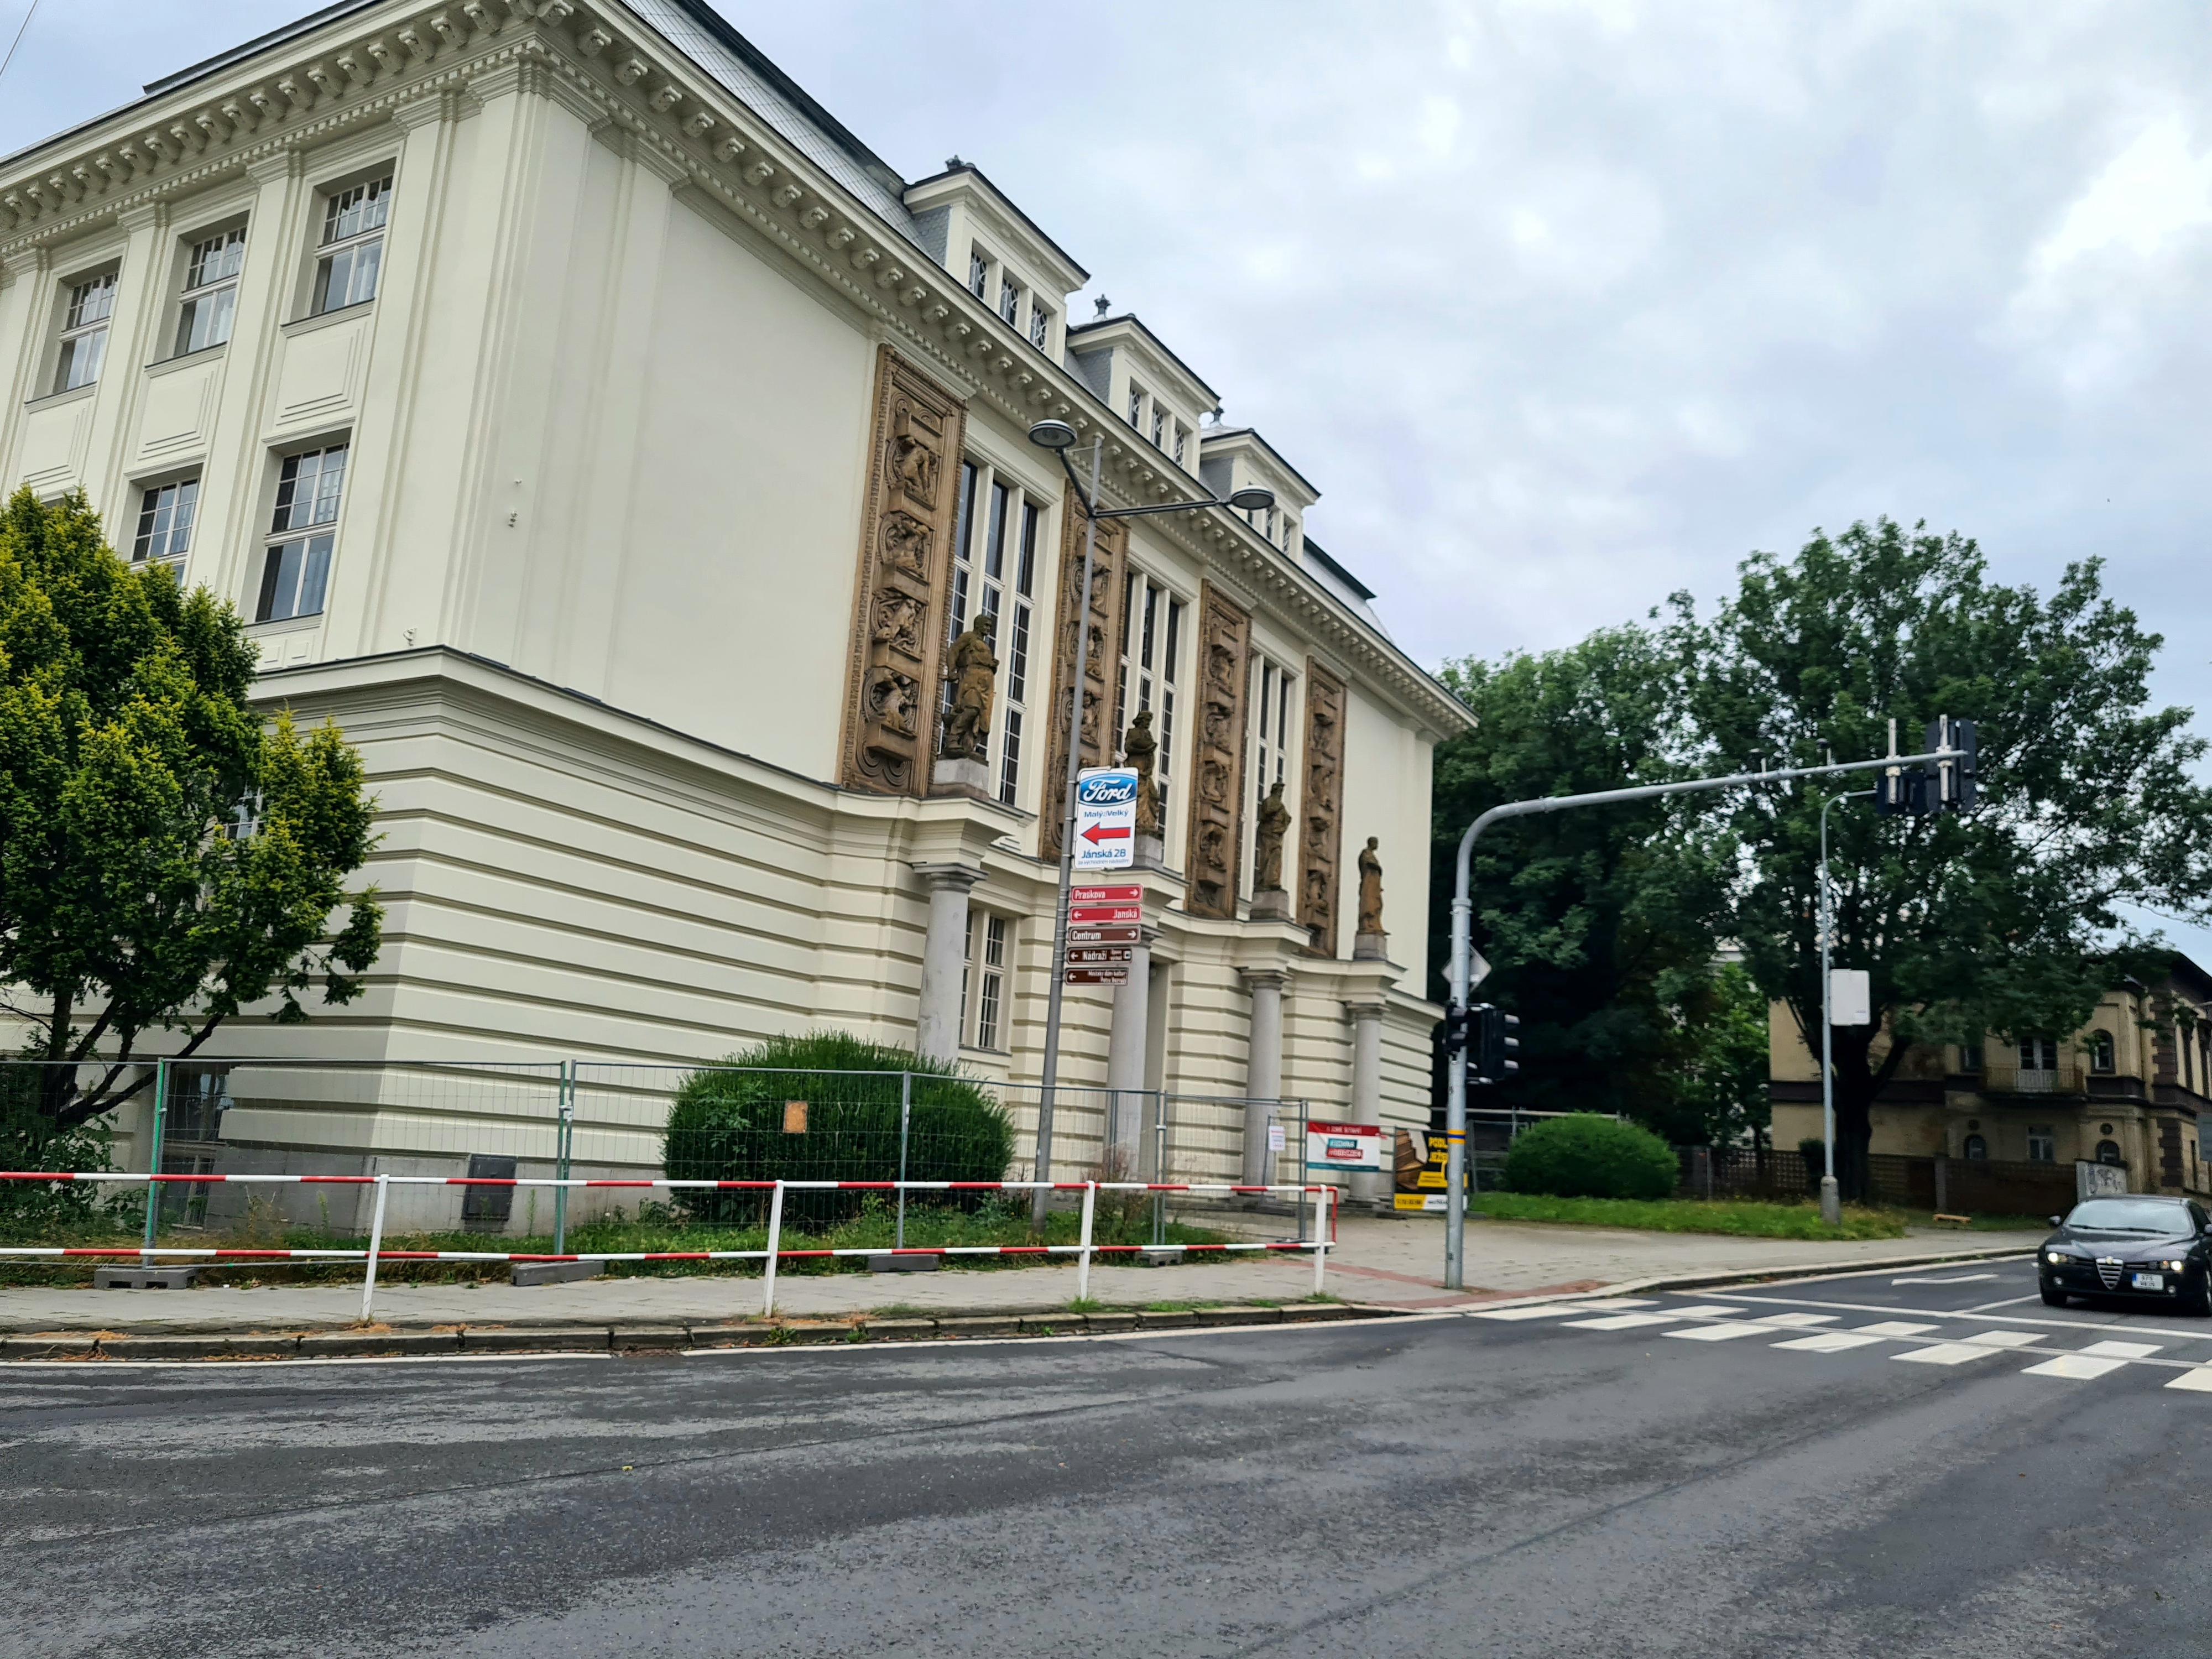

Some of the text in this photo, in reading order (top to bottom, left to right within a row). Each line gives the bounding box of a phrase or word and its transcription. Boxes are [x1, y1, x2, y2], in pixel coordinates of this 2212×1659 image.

[1083, 779, 1132, 801] Ford
[1082, 849, 1126, 858] Jánská 28
[1074, 889, 1106, 899] Praskova
[1072, 930, 1101, 940] Centrum
[1082, 950, 1107, 961] Nádraží
